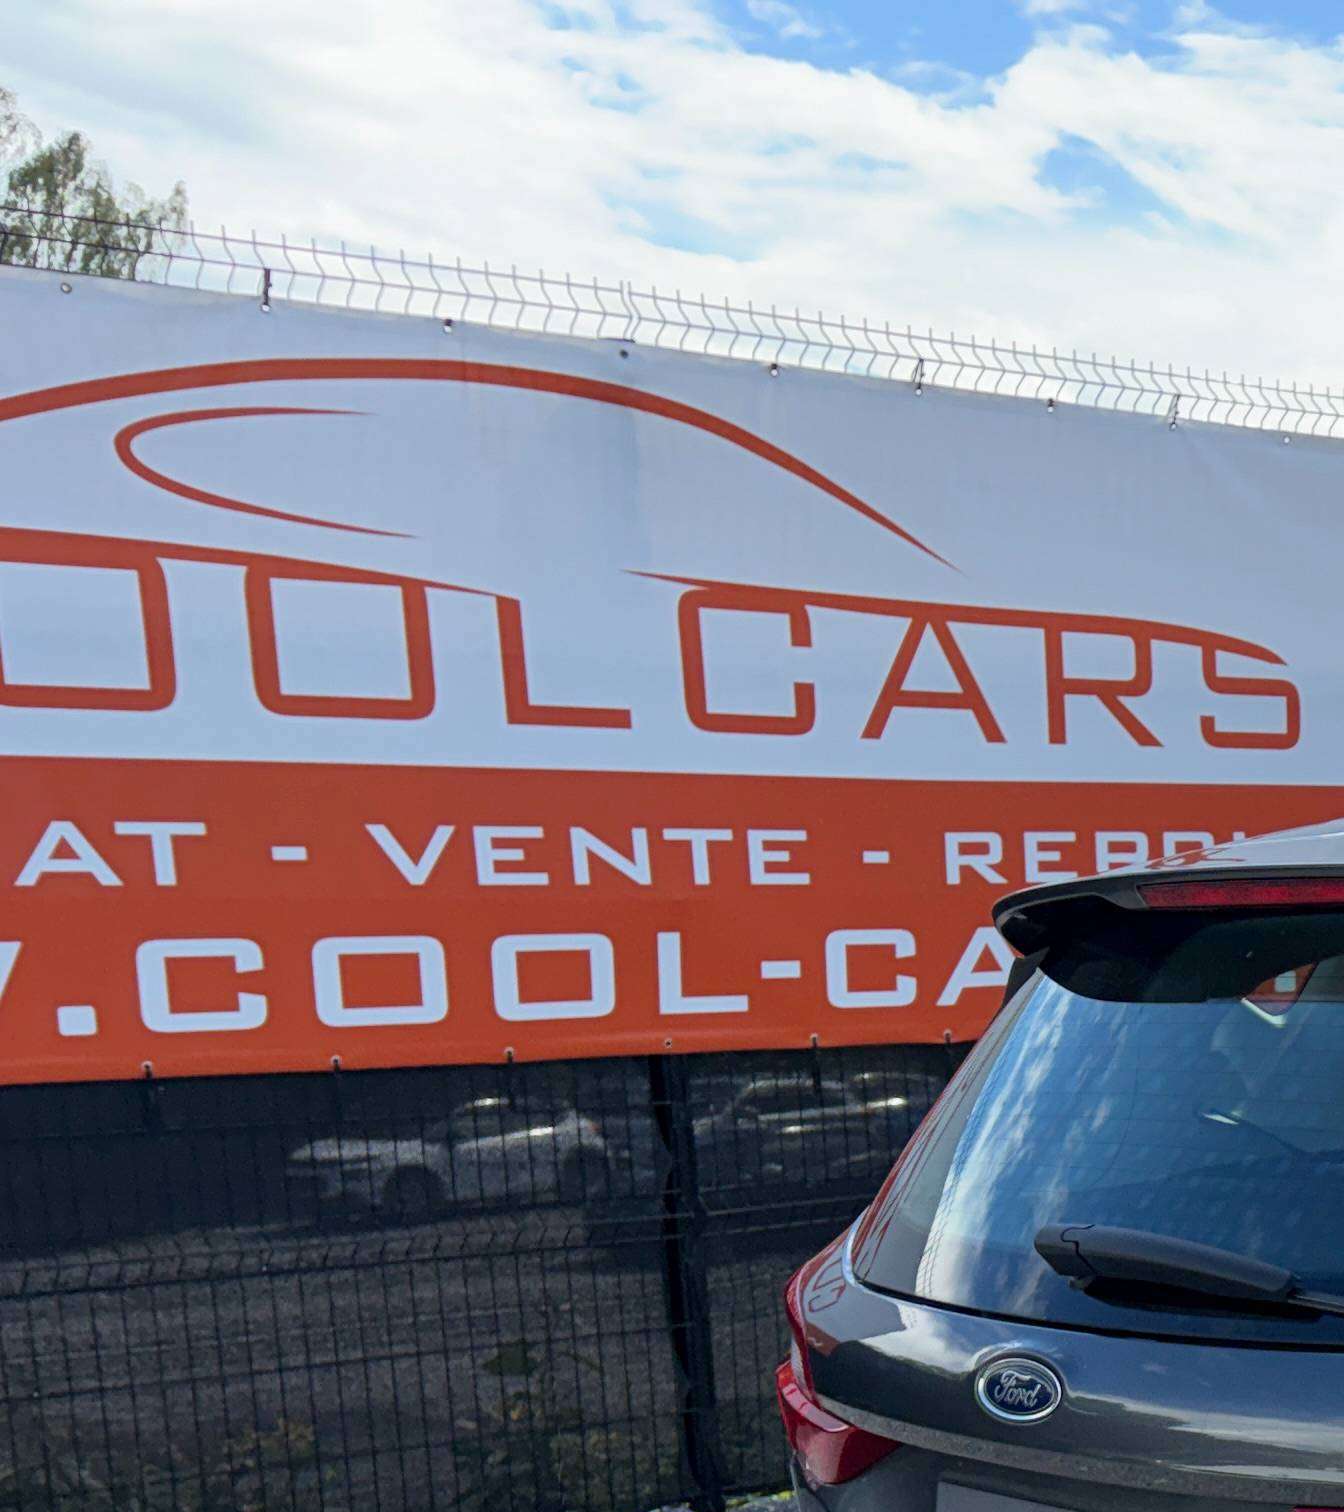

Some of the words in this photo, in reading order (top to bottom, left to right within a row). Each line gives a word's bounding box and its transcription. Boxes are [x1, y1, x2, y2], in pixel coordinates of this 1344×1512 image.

[364, 824, 811, 886] VENTE
[944, 831, 1246, 885] REP
[0, 926, 1015, 1037] .COOL-CA
[994, 1370, 1041, 1408] Ford
